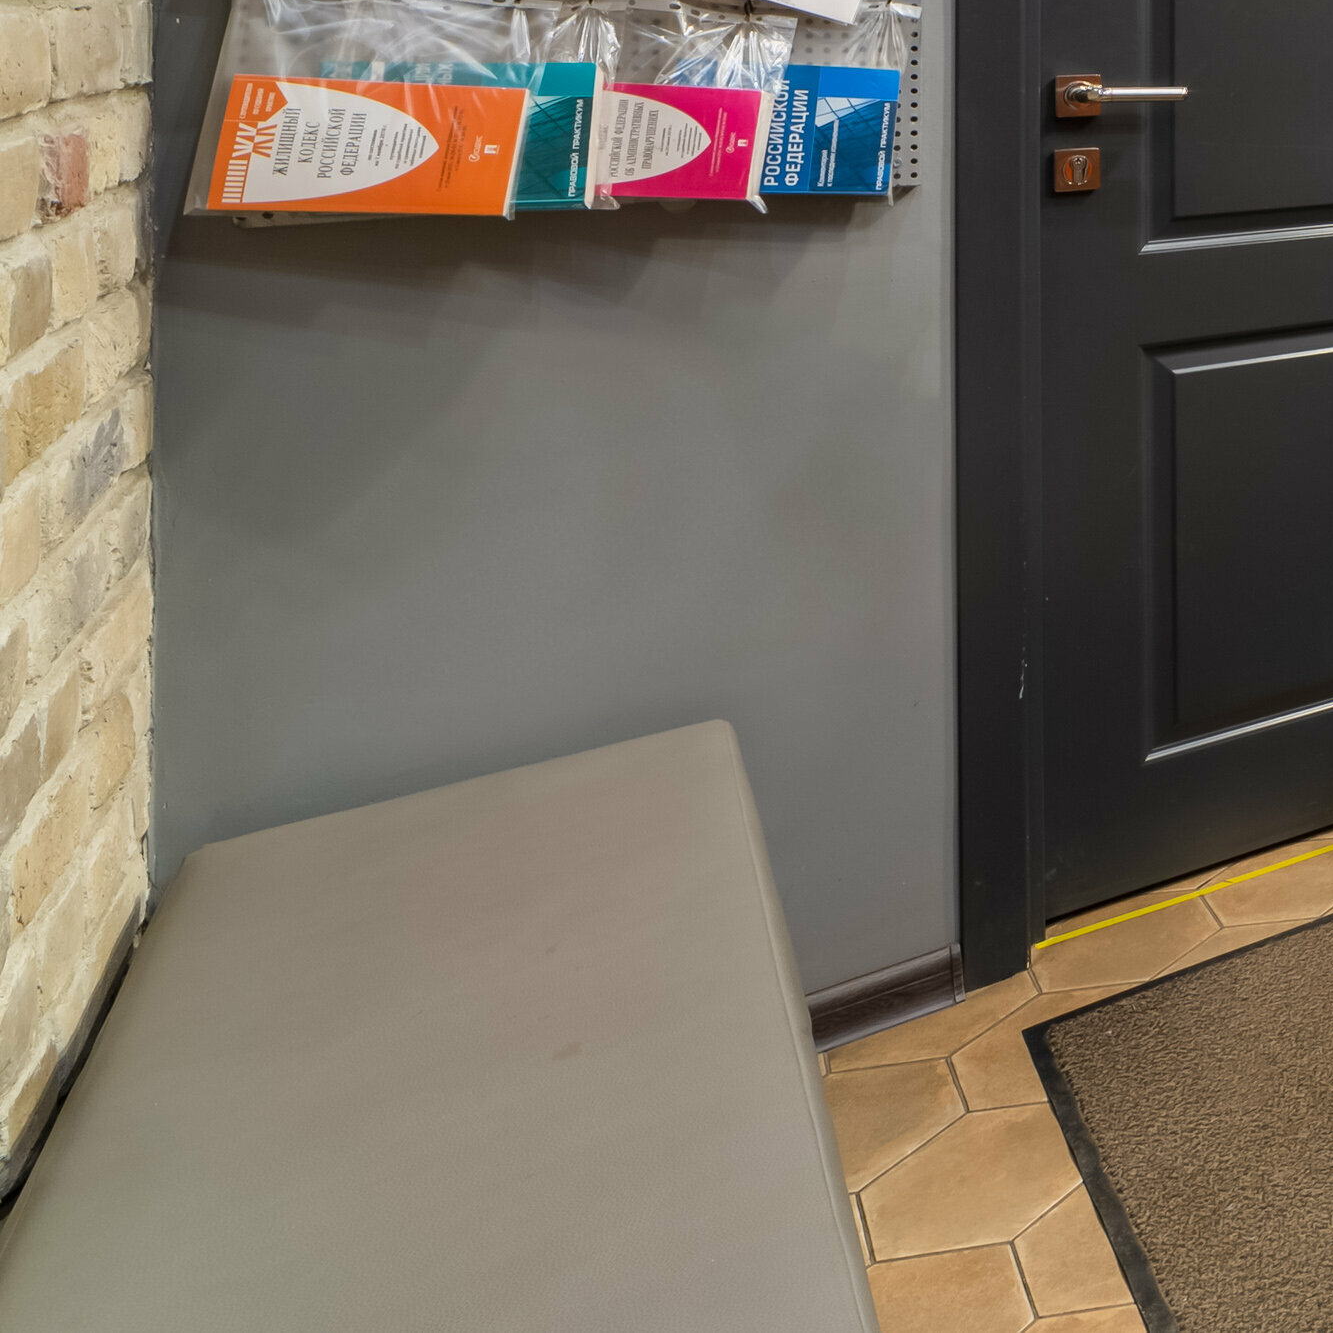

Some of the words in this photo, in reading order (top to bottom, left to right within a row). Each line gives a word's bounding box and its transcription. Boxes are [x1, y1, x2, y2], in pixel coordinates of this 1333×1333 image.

[272, 107, 301, 176] ЖИЛИЩНЫЙ
[298, 122, 320, 164] КОДЕКС
[317, 108, 346, 179] РОССИЙСКОЙ
[340, 113, 367, 176] ФЕДЕРАЦИИ
[572, 99, 584, 149] ПРАКТИКУМ
[614, 99, 629, 135] ФЕДЕРАЦИИ
[626, 102, 644, 166] АДМИНИСТРАТИВНЫХ
[642, 109, 659, 169] ПРАВОНАРУШЕНИЯХ
[764, 79, 790, 186] РОССИЙСКОЙ
[785, 89, 809, 186] ФЕДЕРАЦИИ
[880, 102, 891, 148] ПРАКТИКУМ
[568, 152, 579, 197] ПРАВОВОЙ
[625, 167, 635, 176] ОБ
[876, 151, 886, 190] ПРАВОВОЙ
